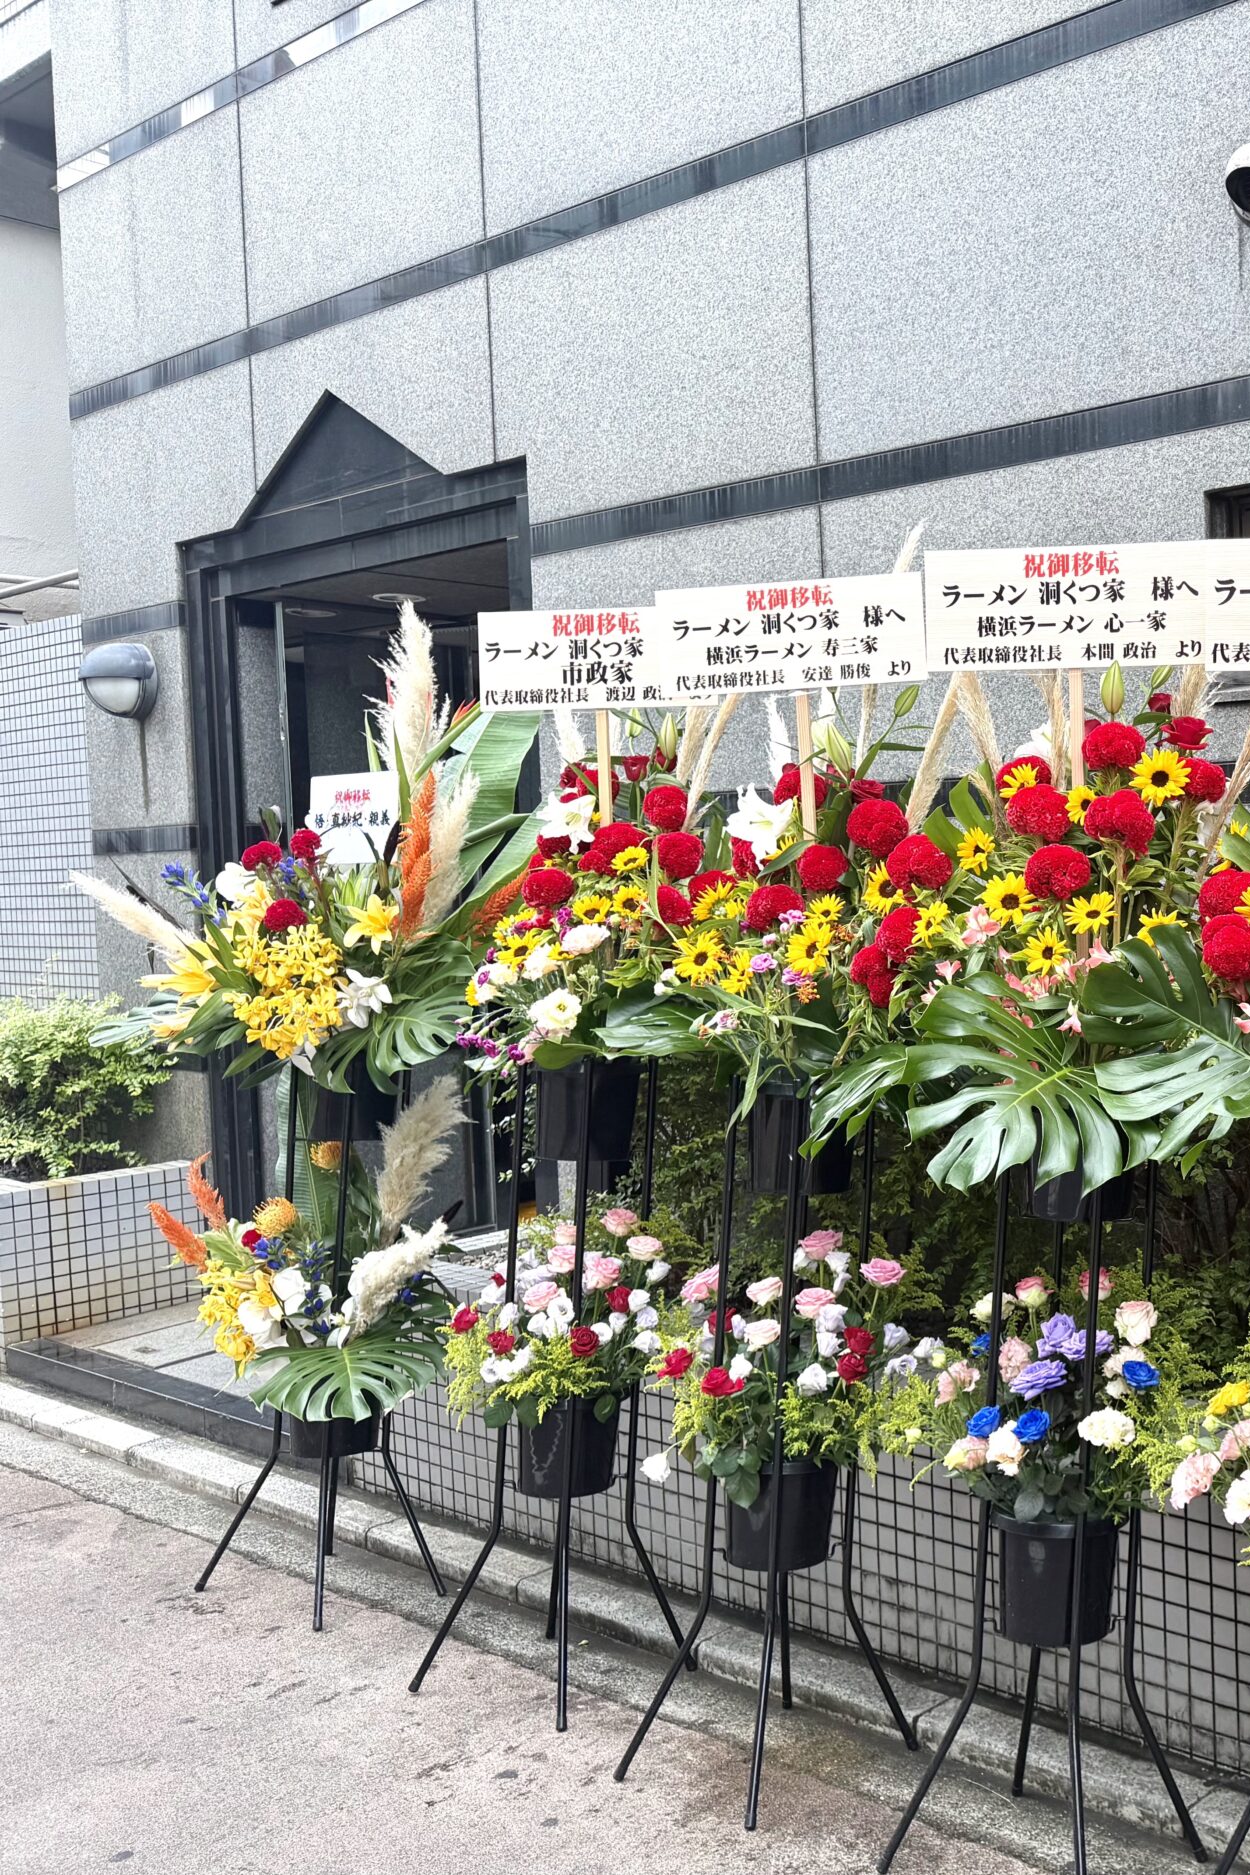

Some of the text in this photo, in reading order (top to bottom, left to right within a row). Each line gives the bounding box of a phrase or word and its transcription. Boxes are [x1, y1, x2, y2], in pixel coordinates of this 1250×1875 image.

[1023, 550, 1119, 578] 祝御移転
[746, 585, 833, 611] 祝御移転
[942, 576, 1199, 608] ラーメン 洞くつ家 様へ
[552, 612, 640, 637] 祝御移転
[673, 605, 906, 641] ラーメン 洞くつ家 様へ
[977, 610, 1167, 637] 横浜ラーメン 心一家
[485, 637, 644, 662] ラーメン 洞くつ家
[706, 635, 878, 666] 横浜ラーメン 寿三家
[944, 639, 1202, 665] 代表取締役社長 本間 政治 より
[561, 660, 633, 685] 市政家
[676, 660, 911, 691] 代表取締役社長 安達 勝俊 より
[485, 687, 588, 705] 代表取締役社長
[606, 686, 635, 702] 渡辺
